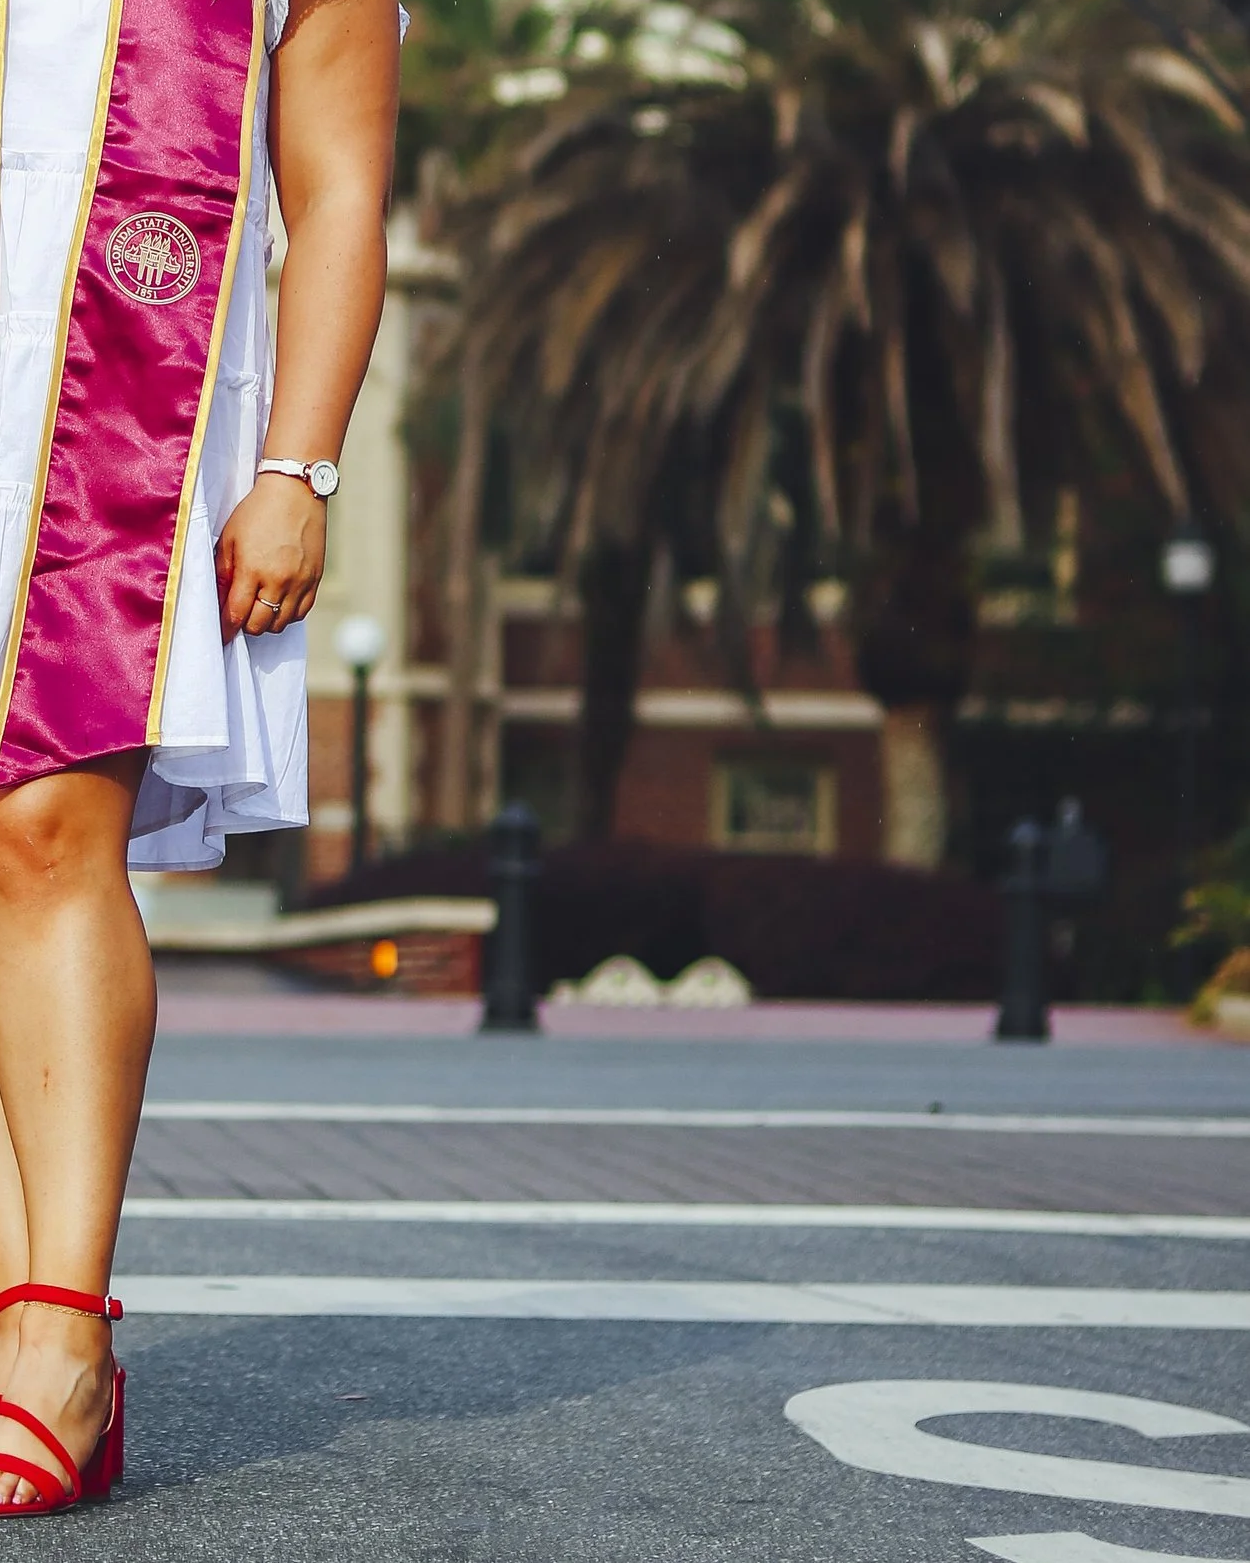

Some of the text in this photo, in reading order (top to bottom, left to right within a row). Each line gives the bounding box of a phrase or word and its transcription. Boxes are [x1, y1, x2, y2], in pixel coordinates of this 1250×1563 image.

[112, 218, 195, 292] FLORIDA STATE UNIVERSITY
[135, 286, 158, 299] 1851
